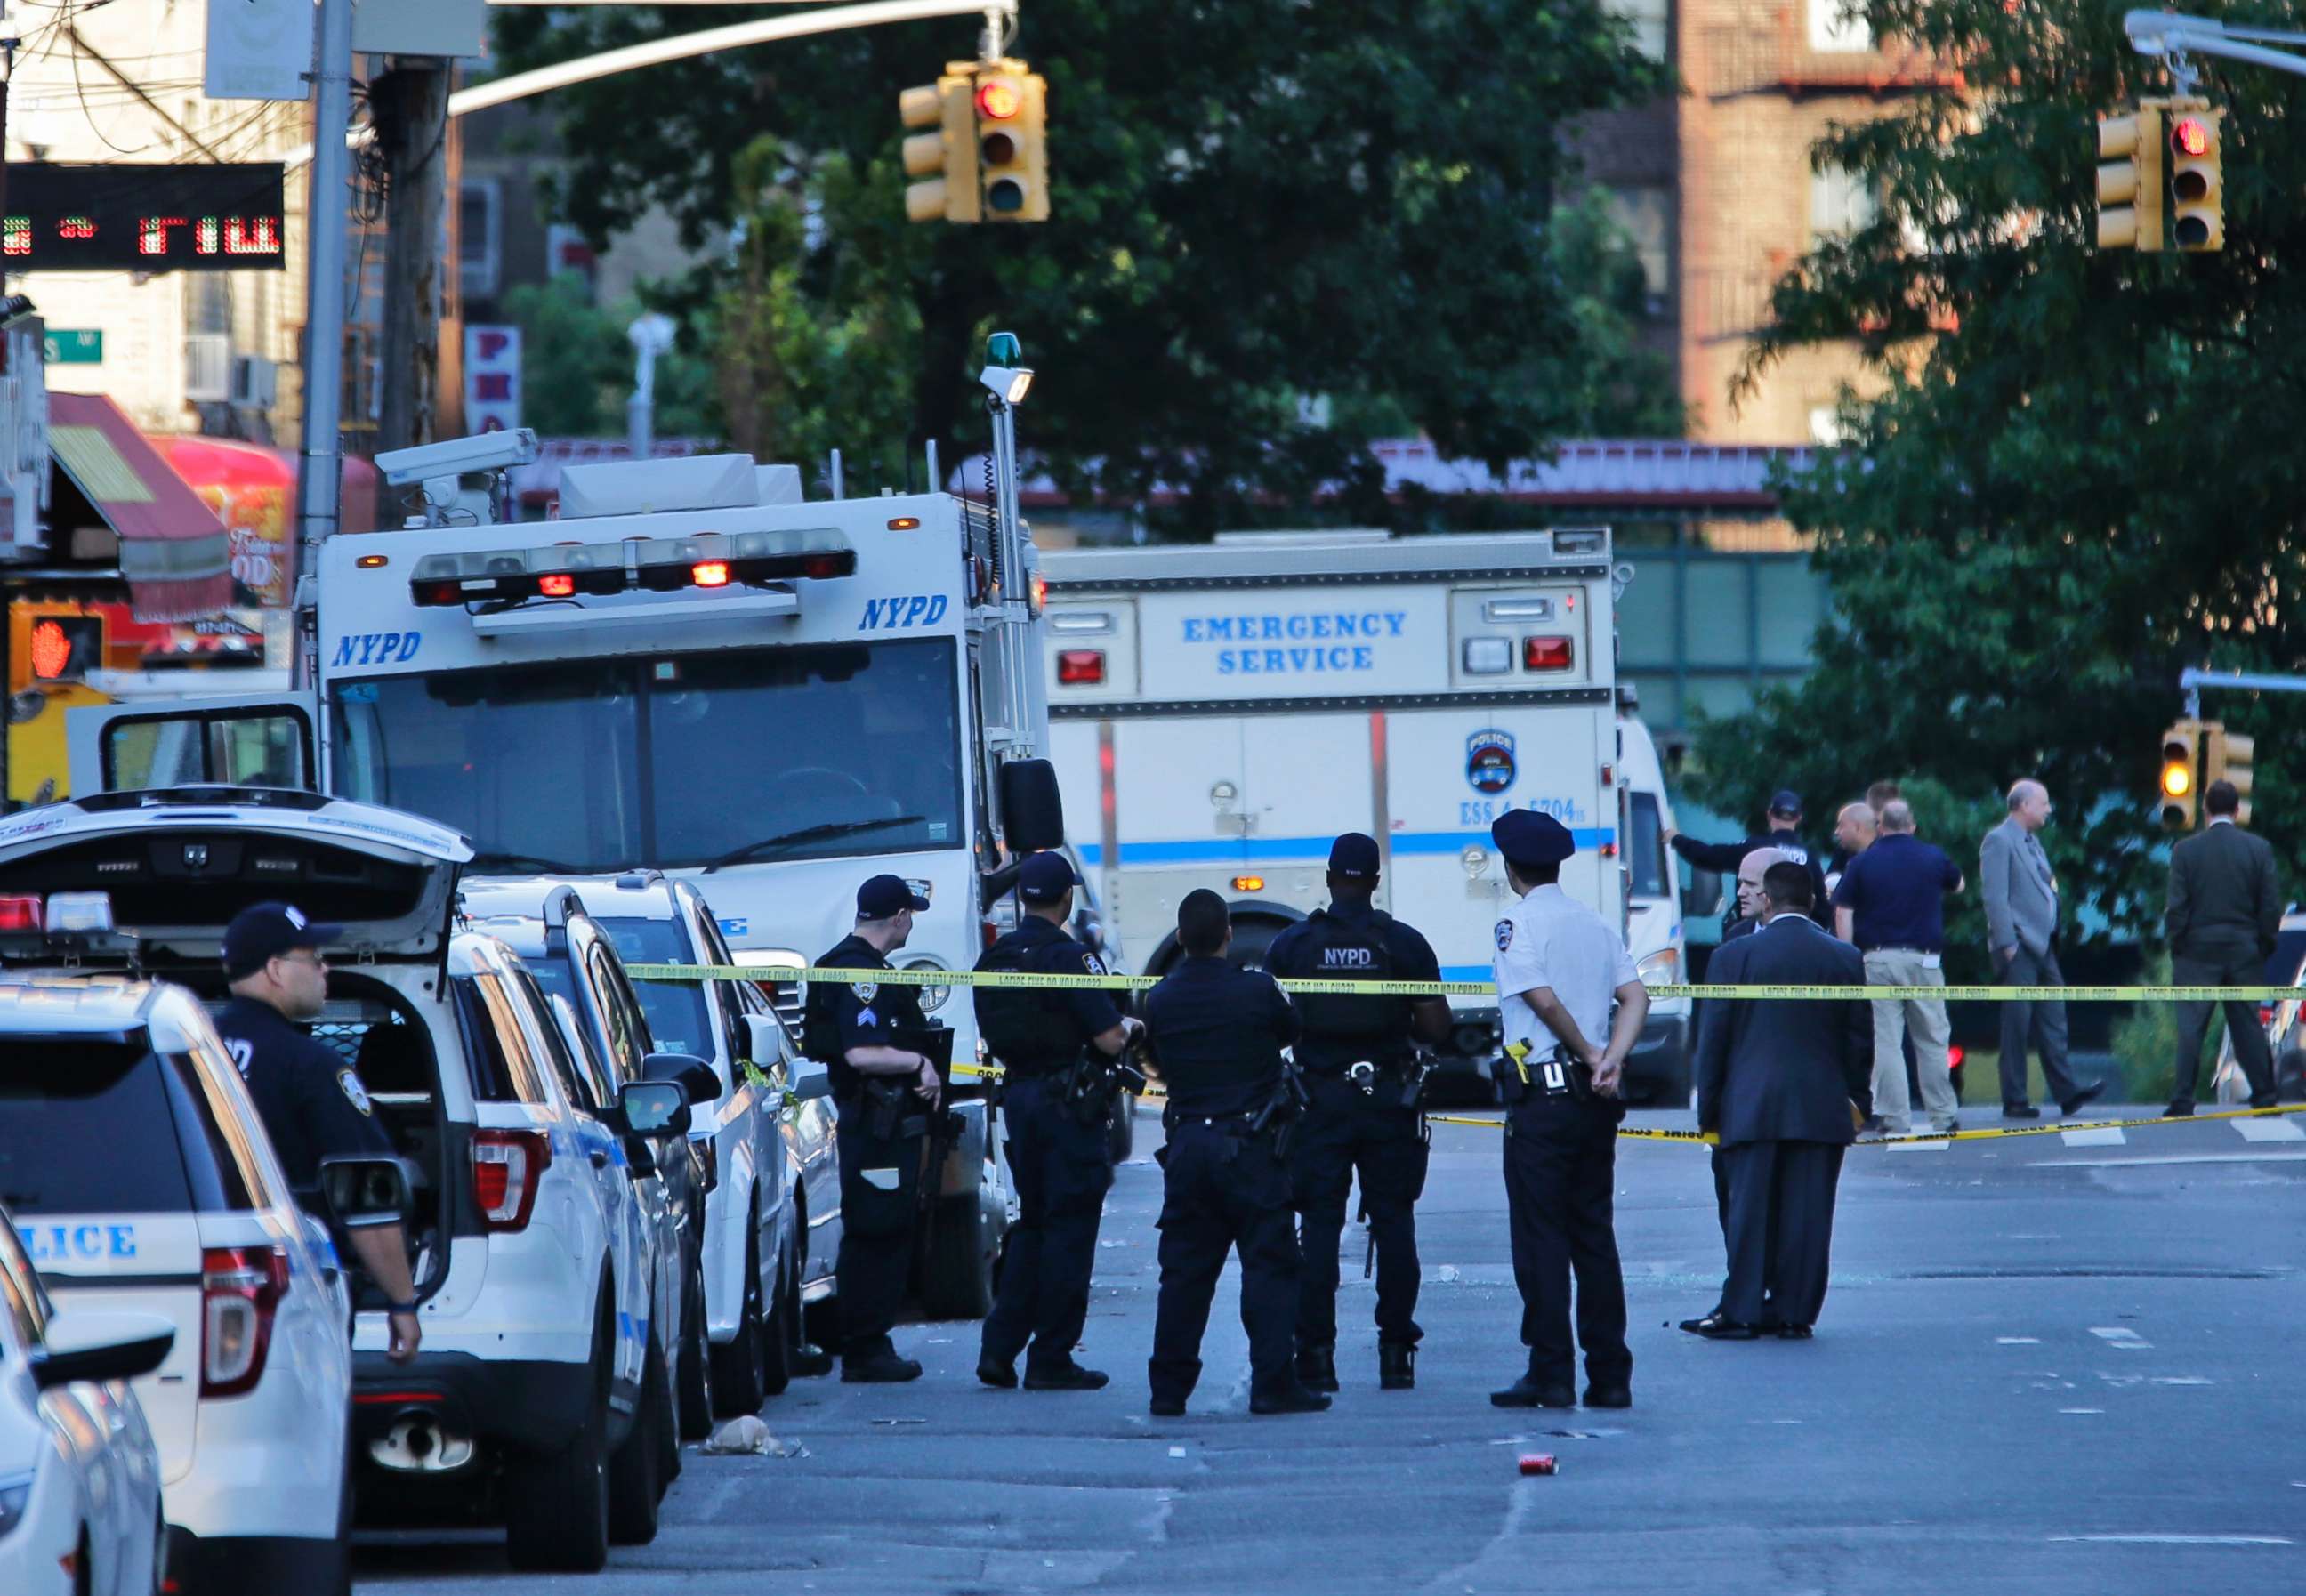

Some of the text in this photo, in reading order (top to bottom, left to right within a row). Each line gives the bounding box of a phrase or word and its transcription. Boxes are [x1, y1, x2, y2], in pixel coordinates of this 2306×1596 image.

[857, 595, 947, 630] NYPD
[1182, 612, 1406, 642] EMERGENCY
[330, 632, 422, 666] NYPD
[1219, 647, 1373, 673] SERVICE
[1470, 733, 1513, 752] POLICE
[1459, 801, 1494, 826] ESS
[1324, 947, 1372, 965] NYPD
[17, 1226, 136, 1259] LICE
